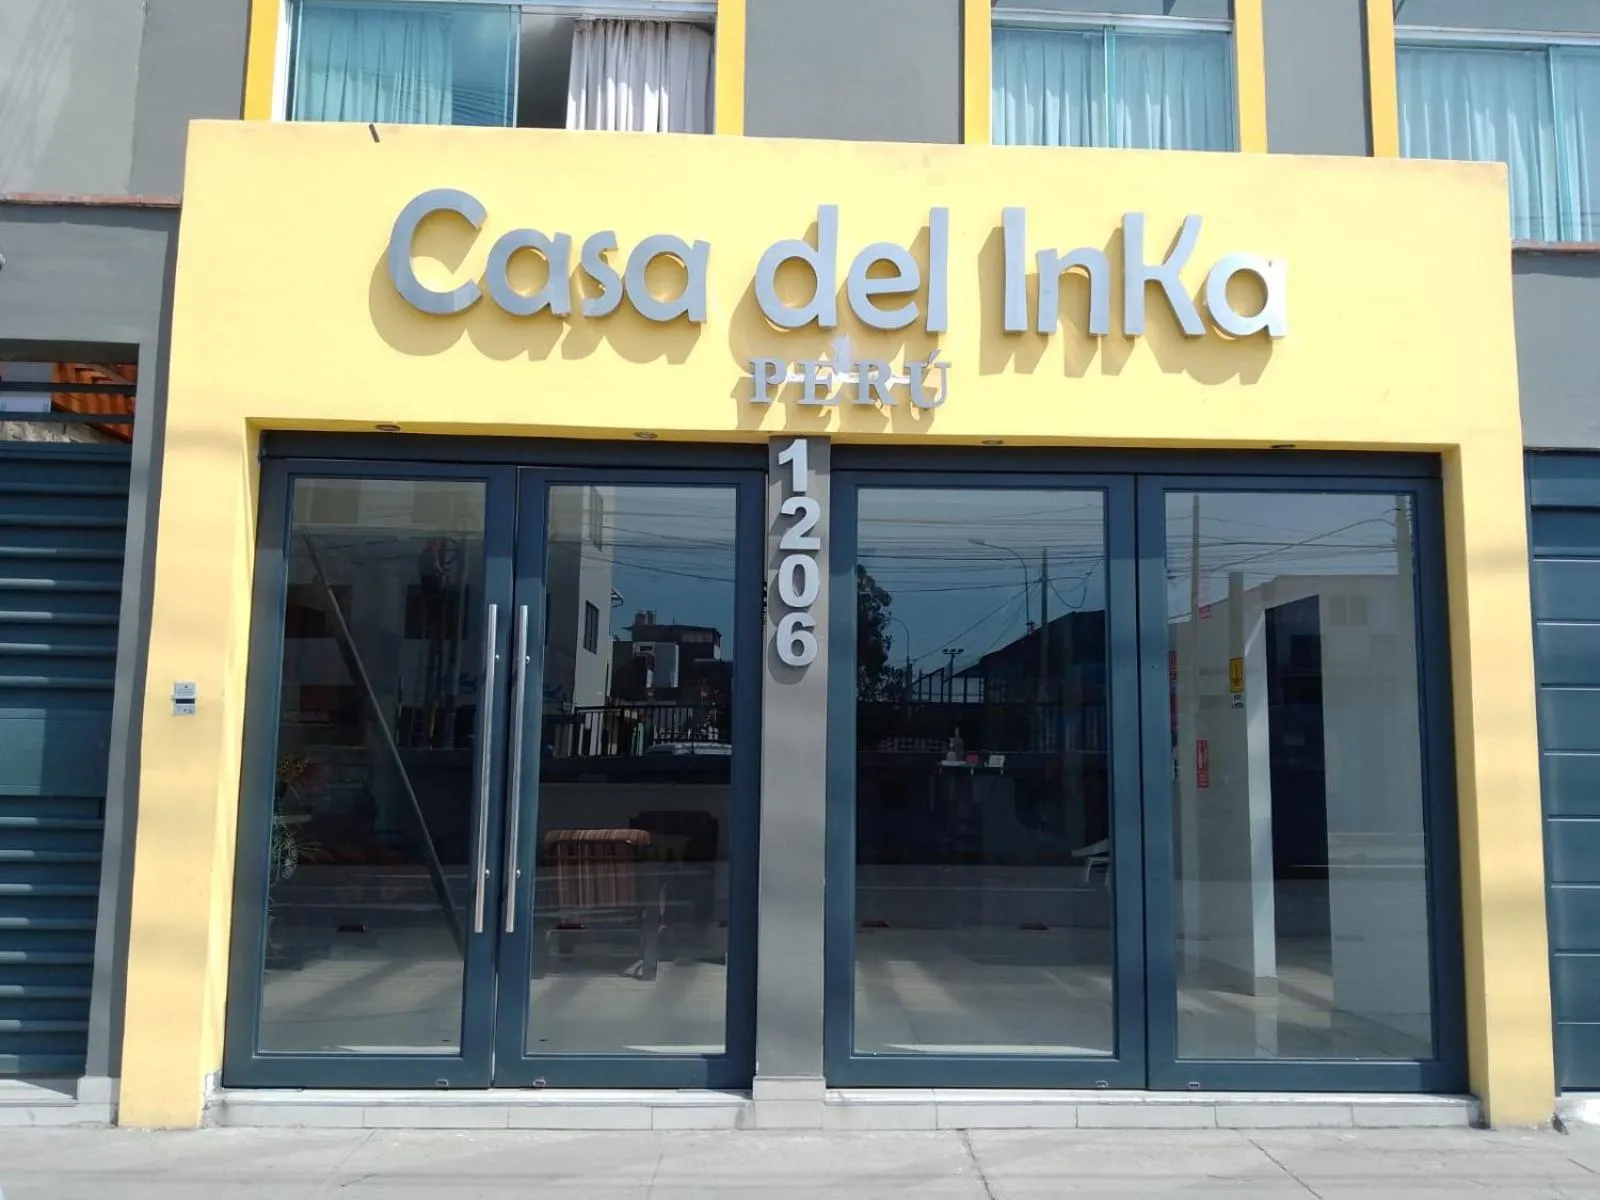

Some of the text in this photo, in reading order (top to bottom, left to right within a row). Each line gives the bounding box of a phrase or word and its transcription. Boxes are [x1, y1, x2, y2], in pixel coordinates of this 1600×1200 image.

[388, 188, 710, 324] Casa
[755, 204, 949, 333] del
[749, 350, 952, 409] PERÚ
[777, 438, 821, 666] 1206
